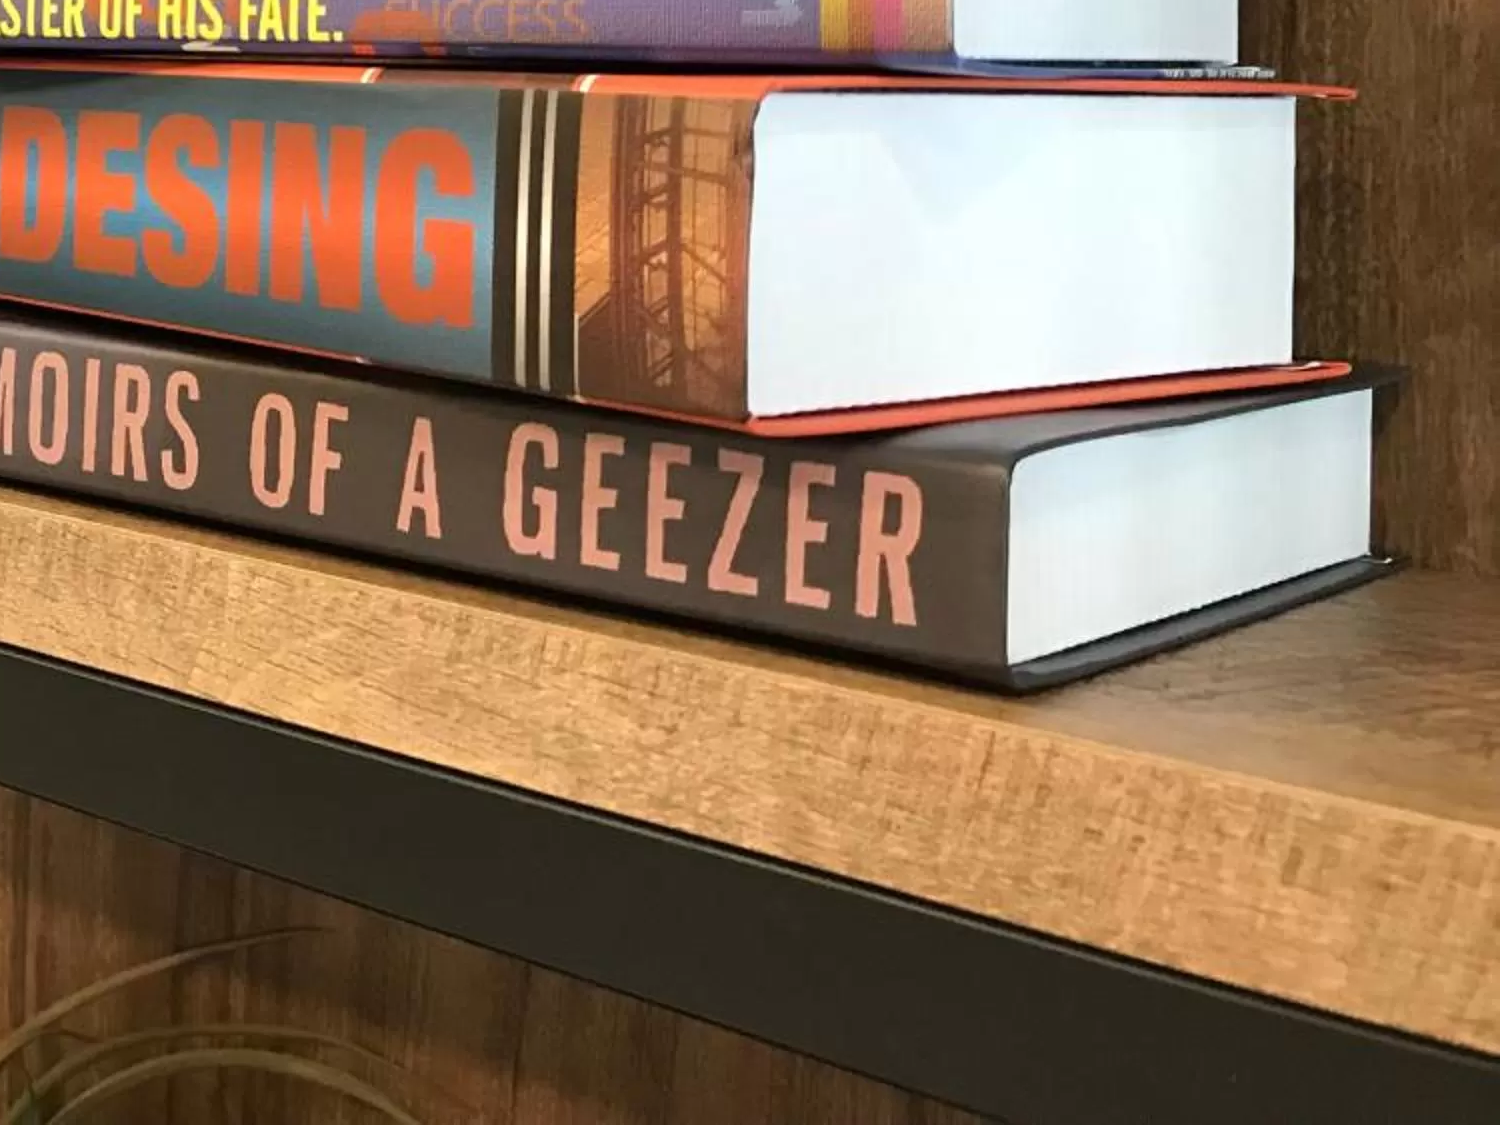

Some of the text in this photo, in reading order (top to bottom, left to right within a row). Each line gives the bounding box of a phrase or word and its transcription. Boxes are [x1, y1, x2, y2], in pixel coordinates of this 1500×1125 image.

[249, 393, 349, 516] OF
[397, 416, 441, 539] A
[502, 422, 924, 627] GEEZER
